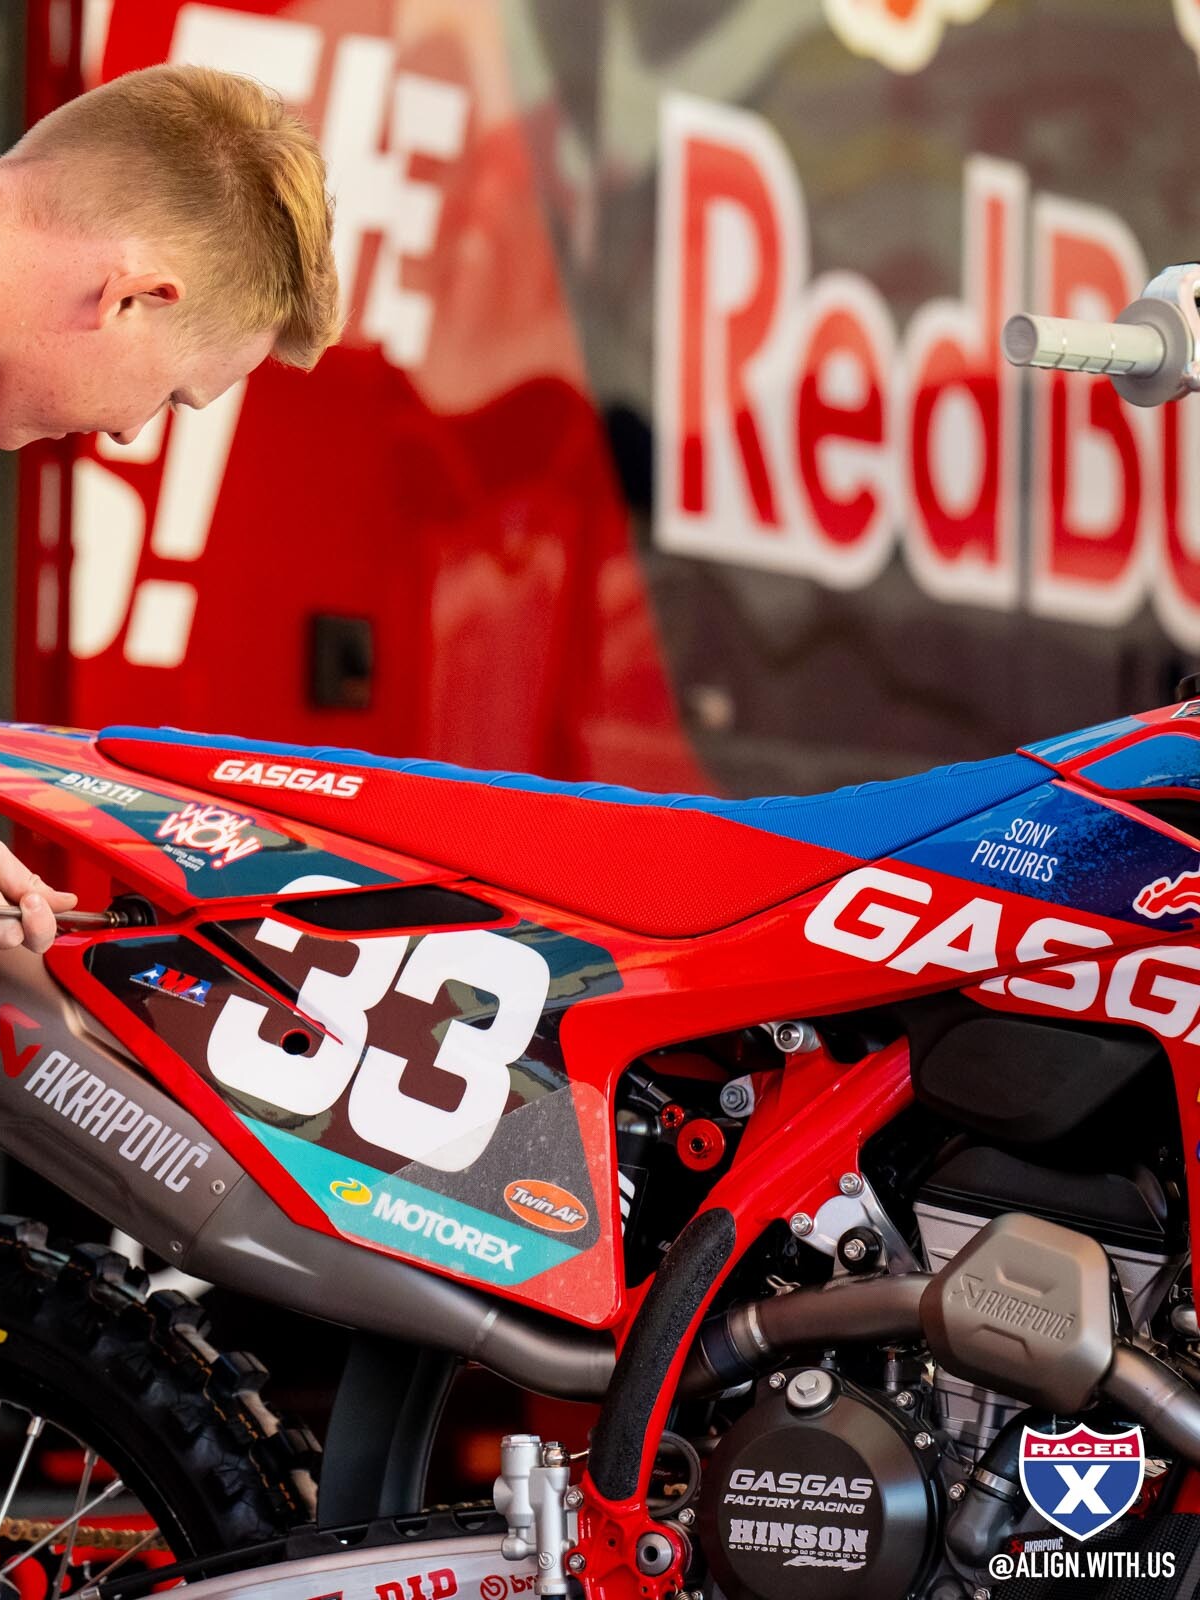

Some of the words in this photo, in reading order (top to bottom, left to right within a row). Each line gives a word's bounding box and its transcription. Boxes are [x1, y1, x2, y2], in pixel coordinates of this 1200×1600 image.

[660, 98, 1022, 592] Red
[60, 773, 144, 803] BN3TH
[212, 759, 363, 797] GASGAS
[1004, 818, 1058, 849] SONY
[970, 839, 1059, 883] PICTURES
[804, 867, 1200, 1044] GASG
[130, 962, 213, 1004] AMA
[206, 875, 550, 1173] 33
[511, 1187, 555, 1214] Twin
[551, 1206, 584, 1224] Air
[372, 1193, 522, 1271] MOTOREX
[729, 1469, 873, 1500] GASGAS
[723, 1494, 800, 1509] FACTORY
[802, 1500, 865, 1515] RACING
[728, 1518, 869, 1553] HINSON
